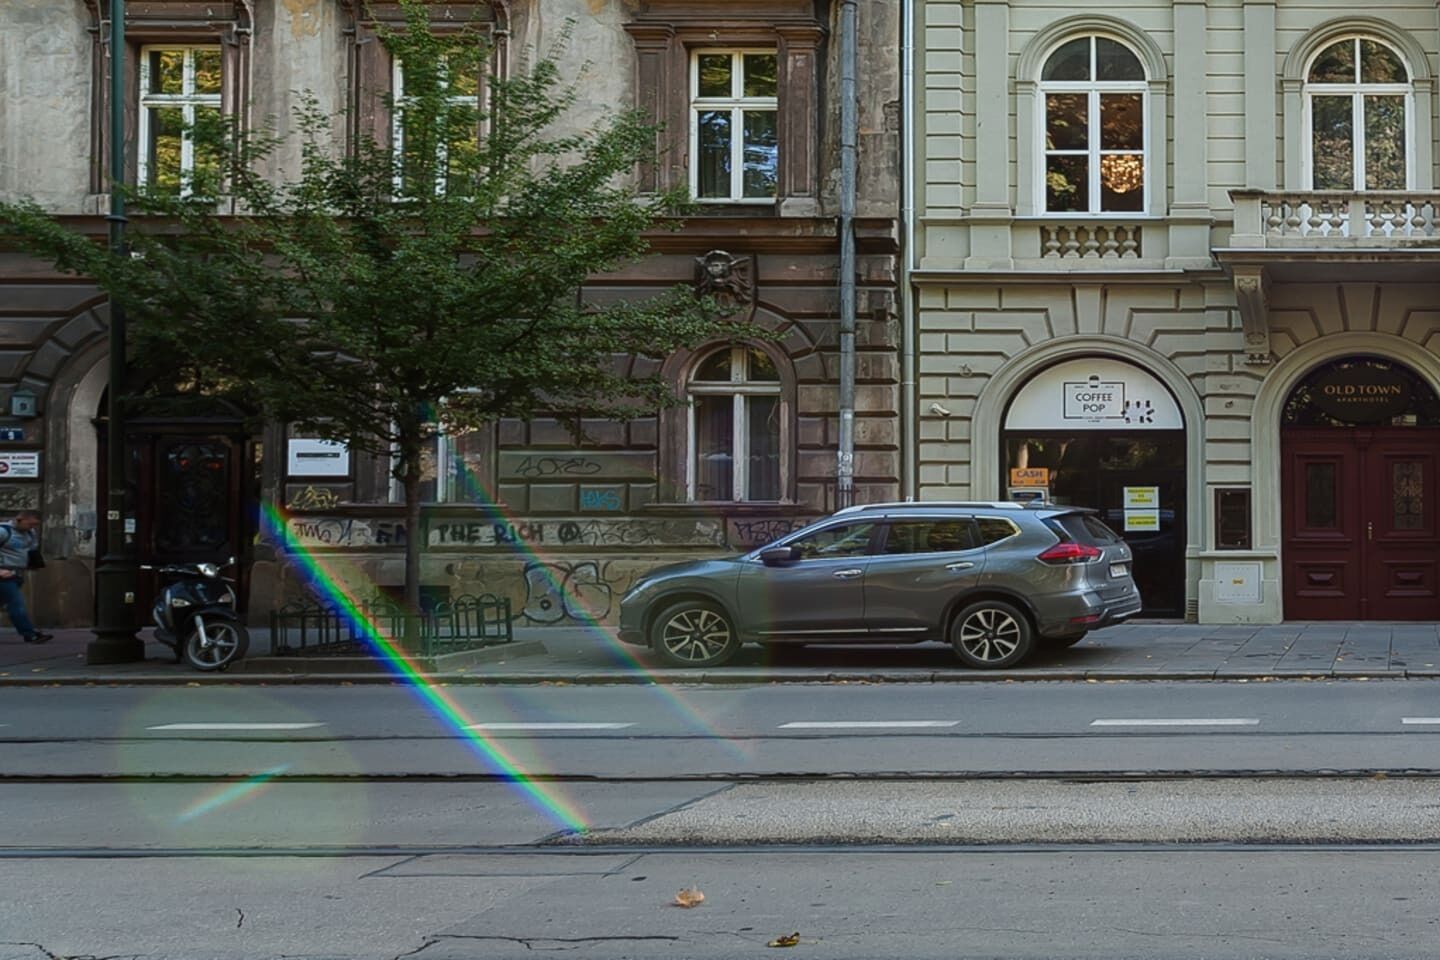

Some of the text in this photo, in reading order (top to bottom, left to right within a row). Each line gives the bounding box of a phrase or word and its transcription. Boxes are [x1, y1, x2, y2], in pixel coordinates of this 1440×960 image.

[1324, 385, 1401, 395] OLD TOWN
[1075, 393, 1113, 402] COFFEE
[1083, 404, 1106, 413] POP
[436, 523, 481, 543] THE
[493, 523, 544, 544] RICH
